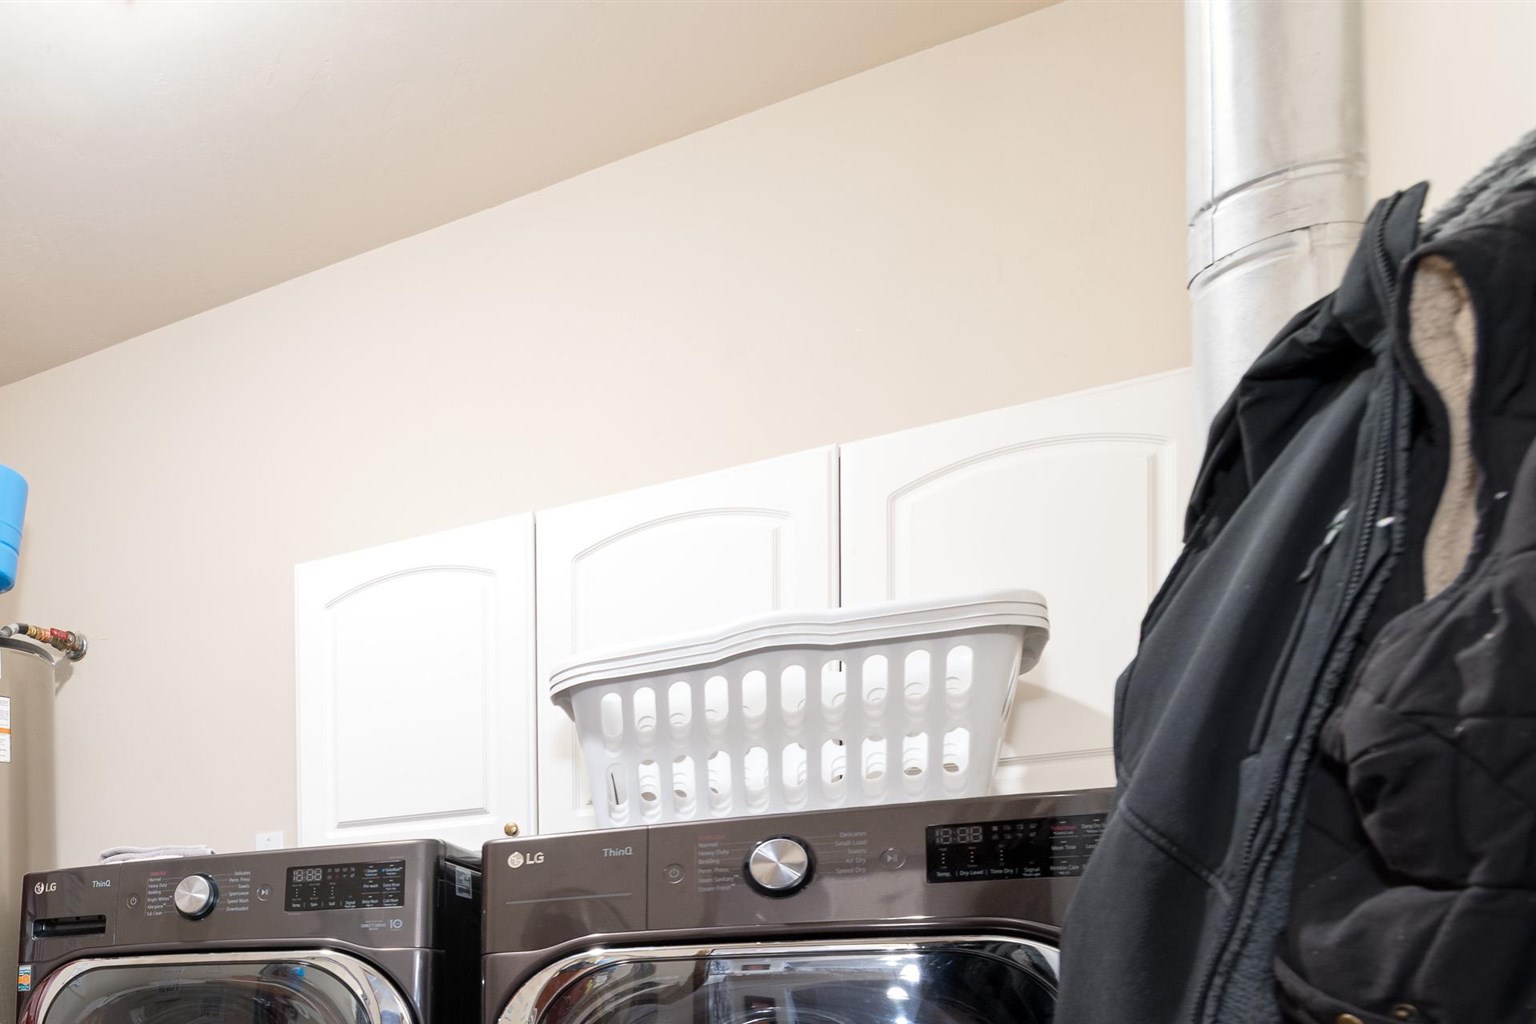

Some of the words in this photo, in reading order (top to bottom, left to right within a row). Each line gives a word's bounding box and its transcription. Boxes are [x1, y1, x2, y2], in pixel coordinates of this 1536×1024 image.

[602, 846, 633, 857] ThinQ
[526, 852, 545, 865] LG
[45, 882, 57, 893] LG
[92, 879, 111, 888] ThinQ
